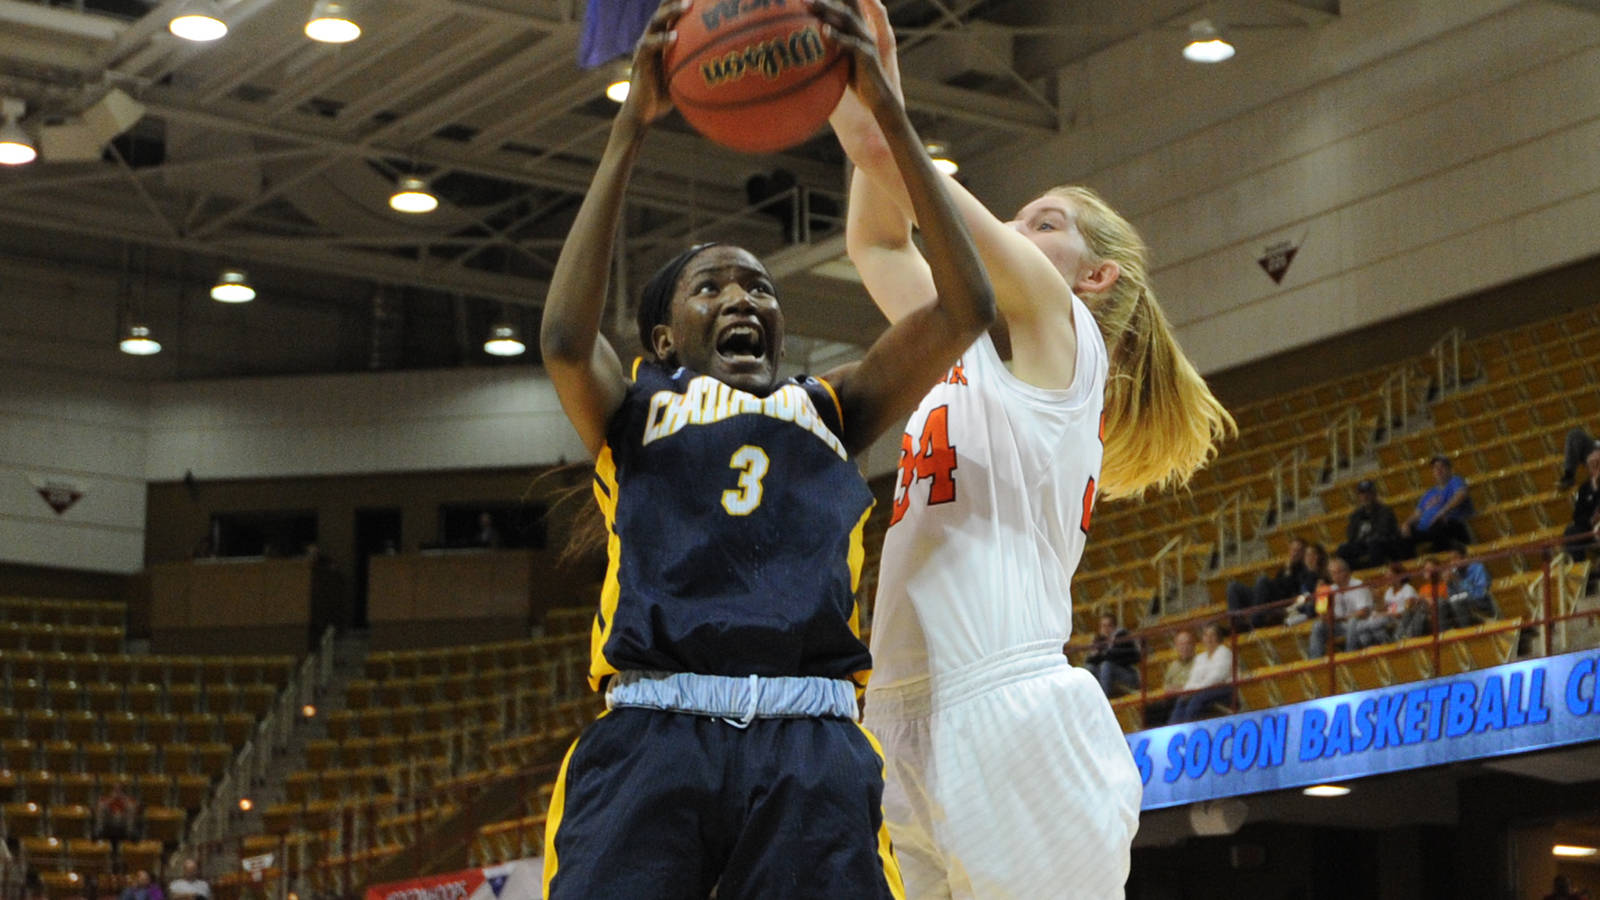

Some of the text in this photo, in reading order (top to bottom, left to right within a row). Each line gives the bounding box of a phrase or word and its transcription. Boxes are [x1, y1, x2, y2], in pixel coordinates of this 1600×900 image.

[701, 0, 787, 31] AA
[702, 26, 826, 87] Wilson
[720, 444, 770, 516] 3
[889, 404, 958, 528] 34
[1128, 737, 1154, 787] 6
[1163, 713, 1288, 784] SOCON
[1300, 667, 1551, 763] BASKETBALL
